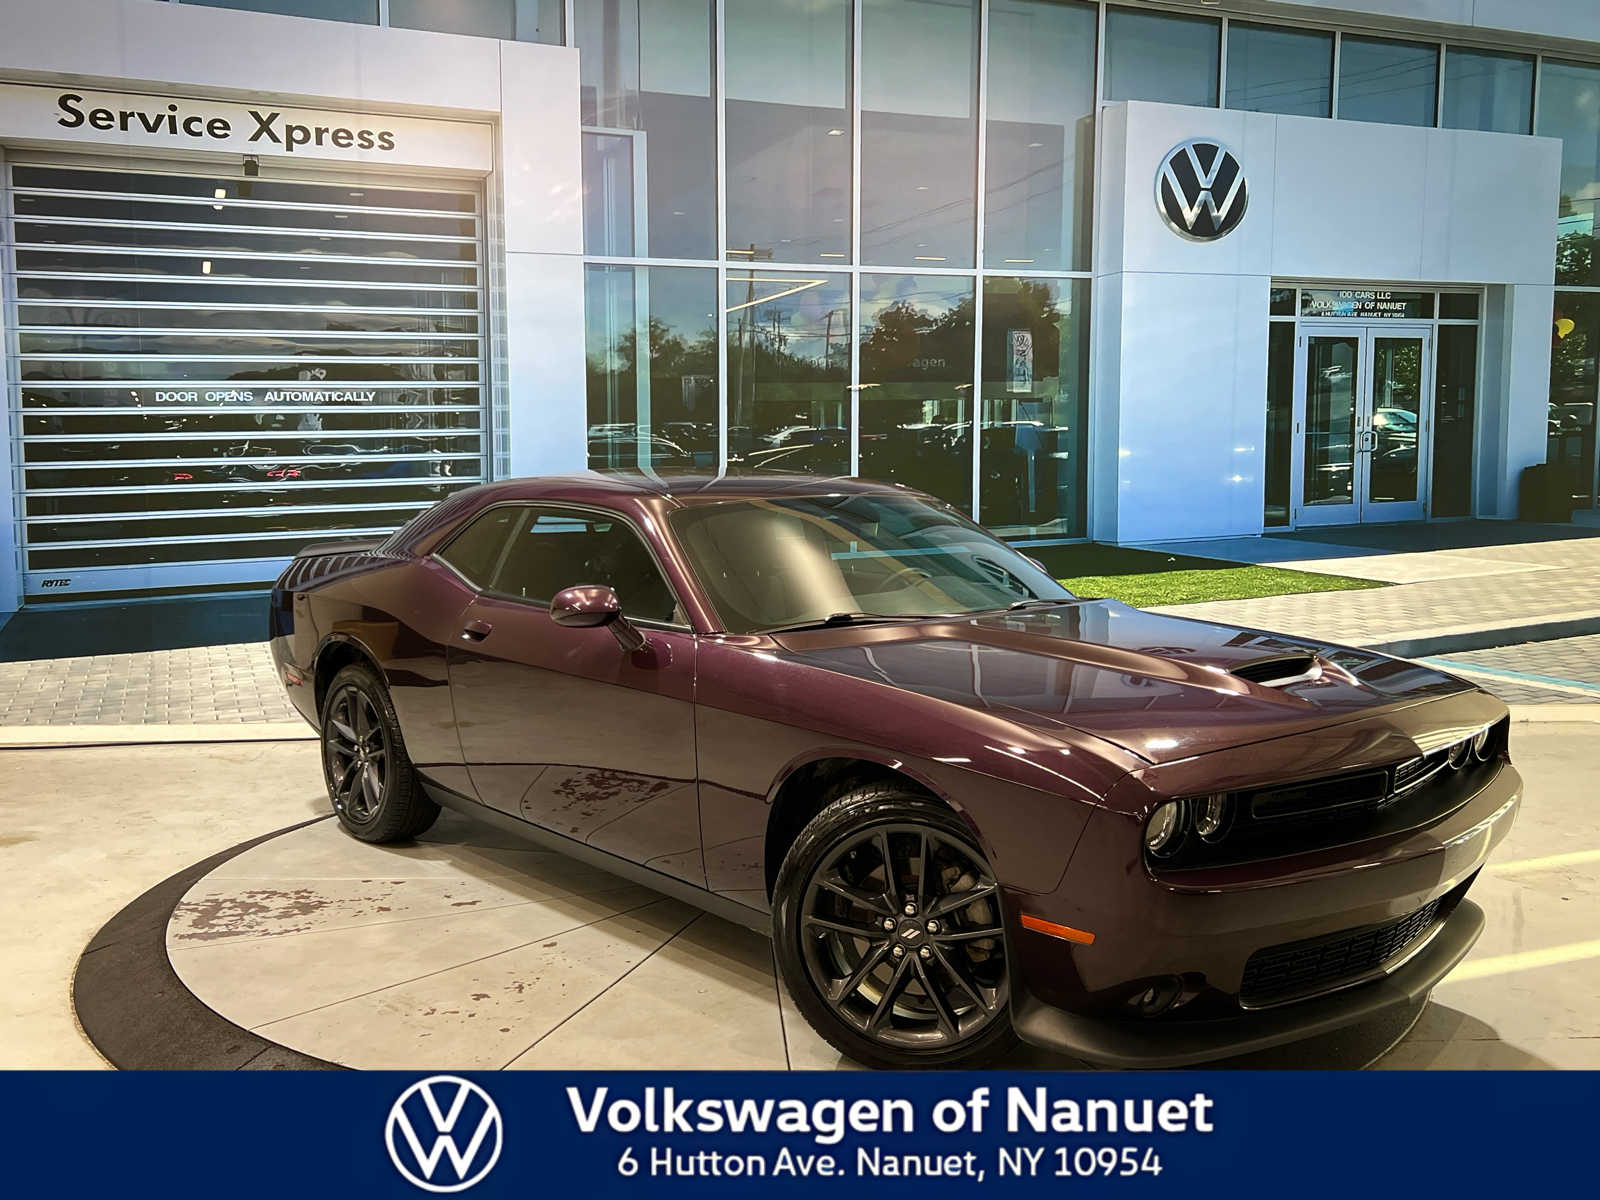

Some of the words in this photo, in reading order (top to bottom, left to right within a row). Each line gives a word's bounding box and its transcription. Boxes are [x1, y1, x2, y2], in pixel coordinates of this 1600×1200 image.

[57, 93, 232, 139] Service
[247, 110, 396, 152] Xpress
[1354, 291, 1375, 300] CARS
[1376, 292, 1392, 300] LLC
[1364, 301, 1376, 310] OF
[1376, 302, 1407, 310] NANUET
[155, 391, 198, 402] DOOR
[204, 391, 254, 402] OPENS
[263, 391, 376, 402] AUTOMATICALLY
[41, 578, 72, 588] RYTEC
